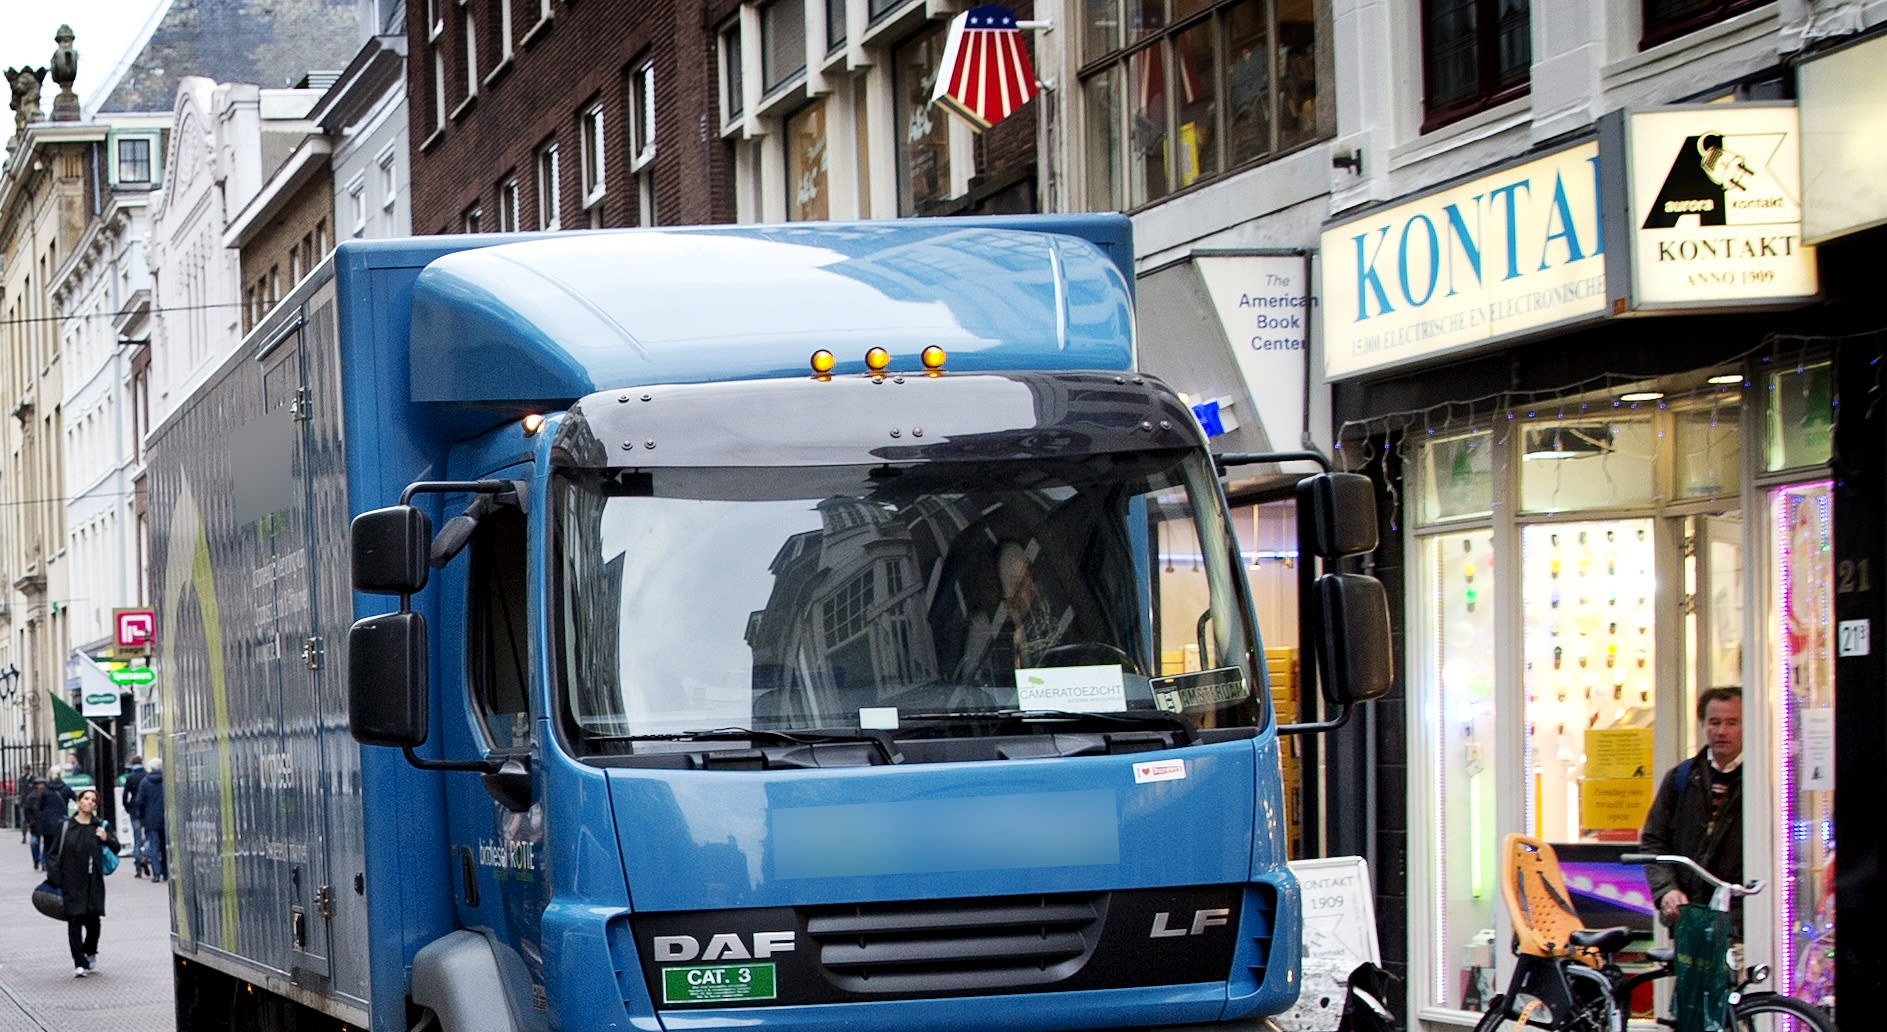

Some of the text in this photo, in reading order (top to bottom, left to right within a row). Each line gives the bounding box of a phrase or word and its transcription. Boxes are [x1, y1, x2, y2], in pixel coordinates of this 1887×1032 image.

[1658, 236, 1797, 262] KONTAKT
[1266, 275, 1290, 287] The
[1686, 269, 1776, 287] ANNO 1909
[1257, 315, 1300, 329] Book
[1838, 559, 1870, 593] 21
[1020, 685, 1121, 700] CAMERATOEZICHT
[1302, 876, 1353, 891] ONTAKT
[1312, 896, 1344, 911] 1909
[1150, 908, 1230, 938] LF
[654, 931, 795, 962] DAF
[687, 968, 752, 985] CAT. 3
